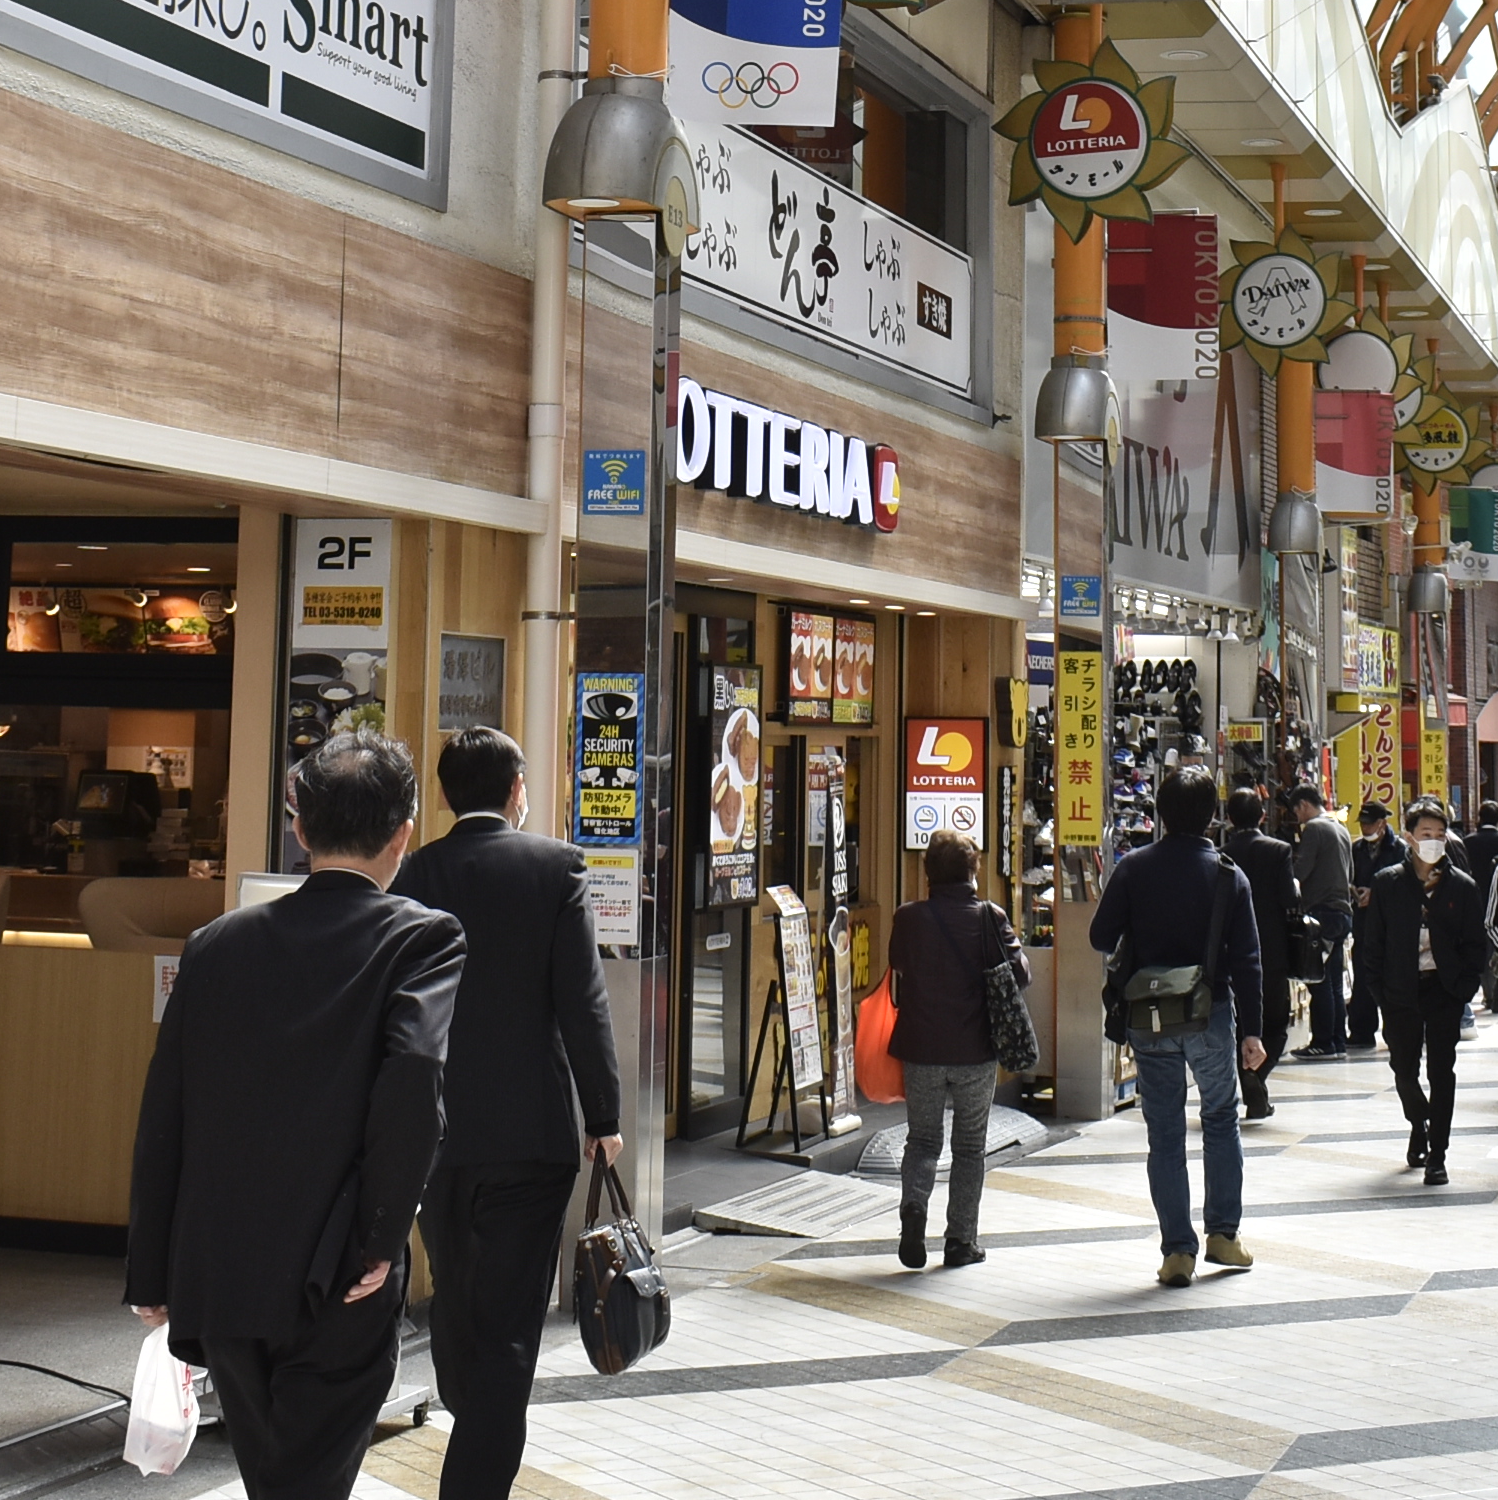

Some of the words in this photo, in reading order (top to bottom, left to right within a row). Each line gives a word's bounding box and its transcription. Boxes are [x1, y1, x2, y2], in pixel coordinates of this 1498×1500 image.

[317, 42, 351, 71] Support
[352, 62, 373, 77] your
[374, 72, 393, 86] good
[394, 77, 417, 103] living
[1046, 134, 1126, 154] LOTTERIA
[1049, 159, 1124, 187] サンモール
[667, 203, 685, 229] E13
[769, 170, 839, 318] どん亭
[862, 221, 902, 281] しゃぶ
[1195, 217, 1218, 304] TOKYO
[1242, 278, 1311, 304] DAIWA
[868, 288, 906, 347] しゃぶ
[921, 290, 948, 334] すき焼
[1247, 318, 1305, 338] サンモール
[1194, 312, 1219, 380] 2020
[1412, 452, 1455, 466] サンモール
[587, 489, 614, 500] FREE
[317, 536, 372, 570] 2F
[304, 606, 317, 618] TEL
[319, 606, 381, 618] 03-5318-0240
[583, 678, 638, 692] WARNING!
[1063, 658, 1079, 748] 客引き
[1081, 658, 1097, 748] チラシ配り
[599, 725, 619, 738] 24H
[584, 739, 634, 752] SECURITY
[584, 753, 634, 766] CAMERAS
[1424, 734, 1433, 784] 客引き
[1434, 734, 1444, 785] チラシ配り
[913, 776, 976, 786] LOTTERIA
[1068, 759, 1093, 822] 禁止
[584, 792, 632, 803] 防犯カメラ
[590, 805, 627, 816] 作動中!
[583, 819, 632, 827] 警察官パトロール
[594, 827, 620, 835] 強化地区
[1063, 834, 1097, 842] 中野警察署
